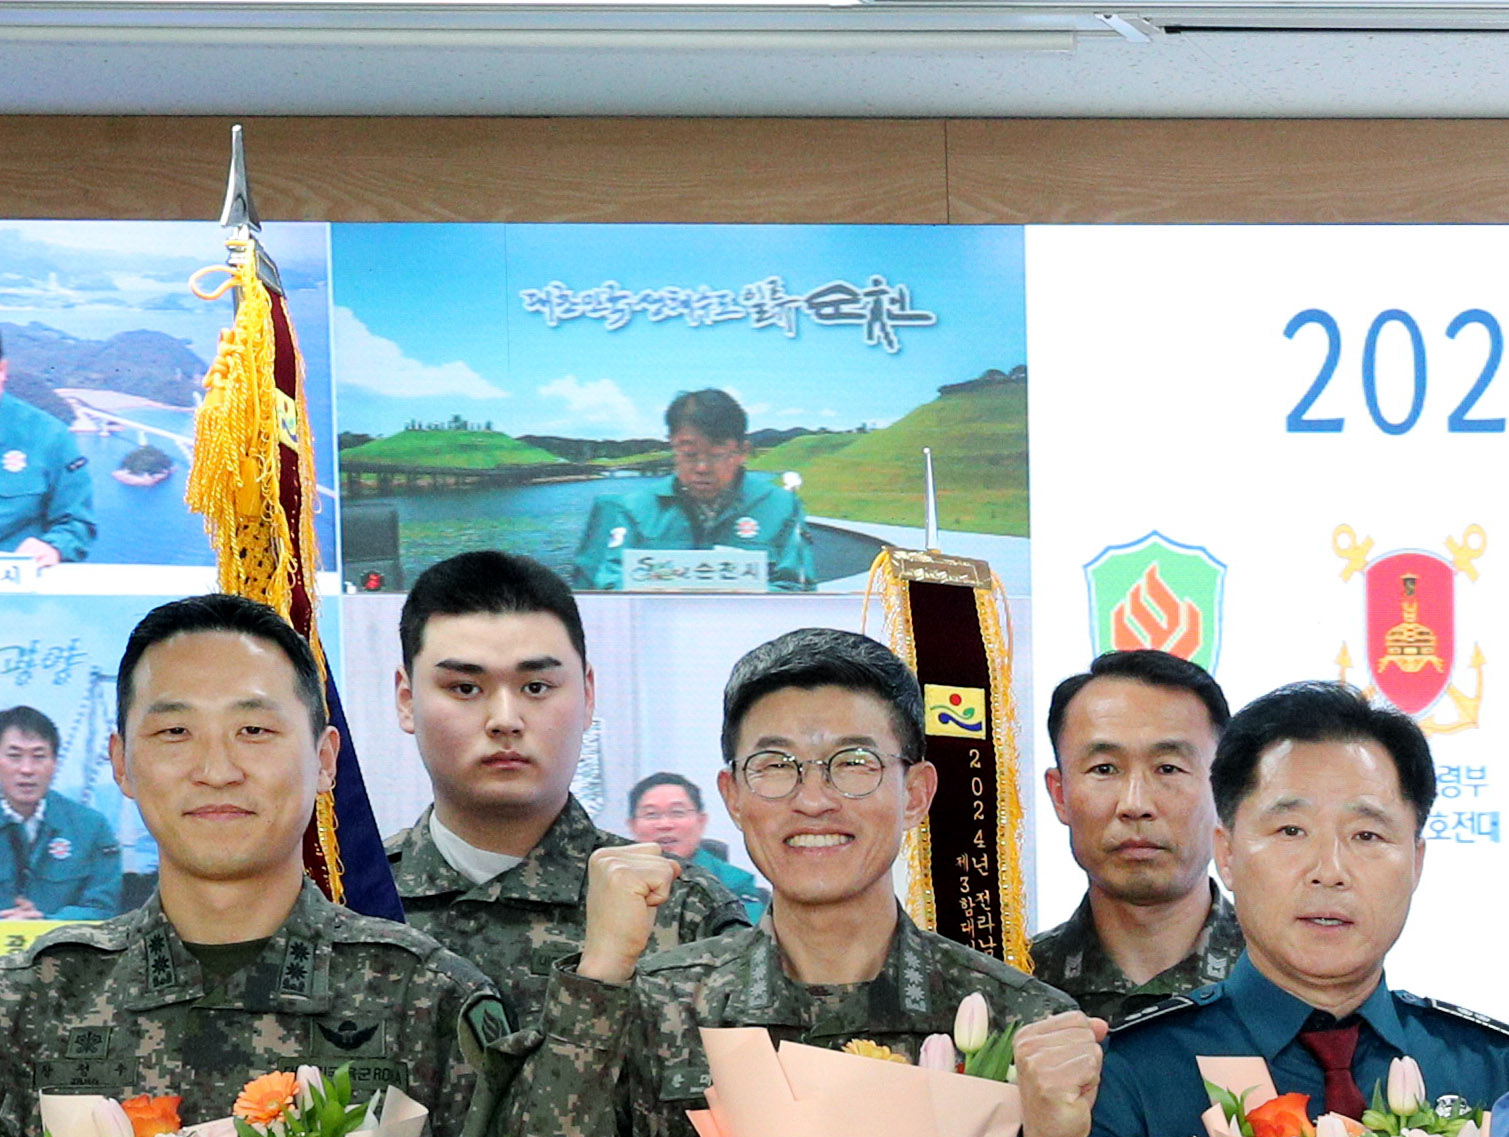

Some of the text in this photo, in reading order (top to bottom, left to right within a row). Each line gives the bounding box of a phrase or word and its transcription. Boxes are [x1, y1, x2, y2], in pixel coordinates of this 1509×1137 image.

[803, 273, 938, 354] 순천
[694, 562, 759, 581] 순천시
[1437, 764, 1489, 799] 령부
[1427, 810, 1501, 844] 호전대
[968, 748, 999, 958] 2024년 전라남
